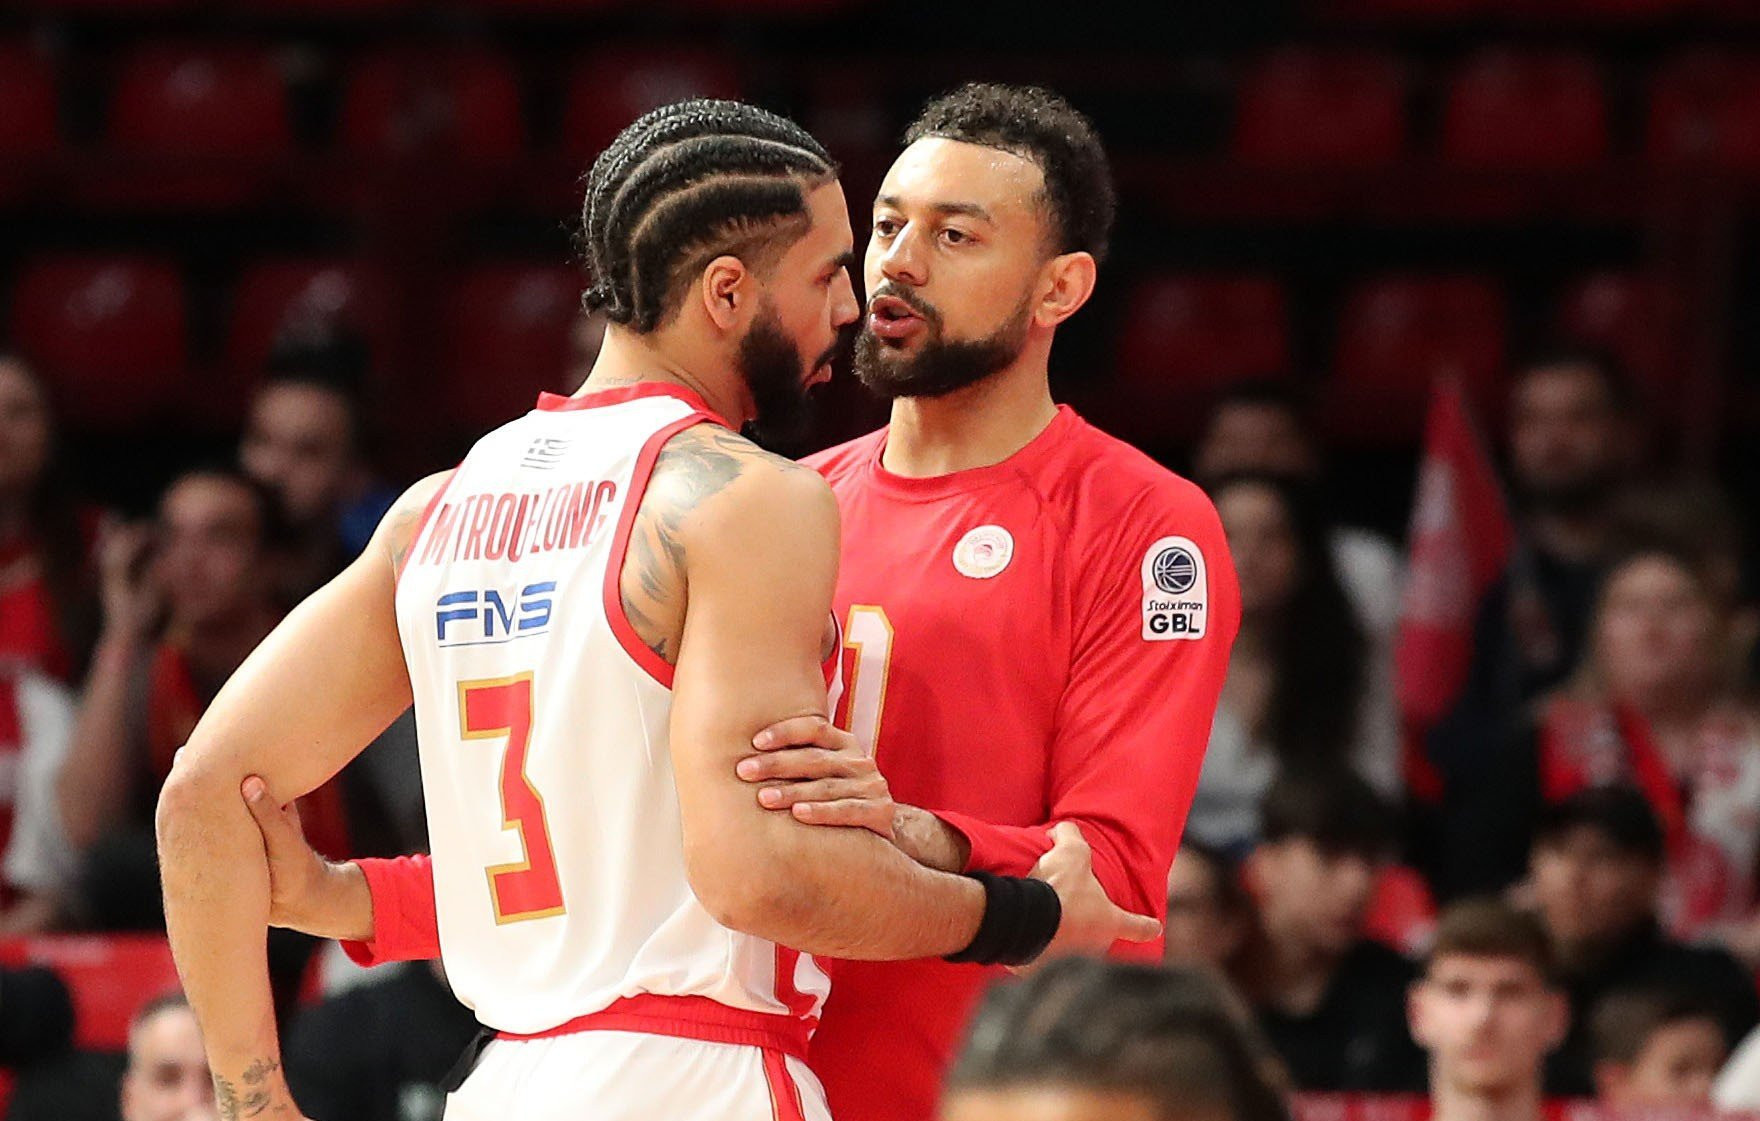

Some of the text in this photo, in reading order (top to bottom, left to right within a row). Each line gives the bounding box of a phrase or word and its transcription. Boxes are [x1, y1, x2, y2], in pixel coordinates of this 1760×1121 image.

[436, 580, 557, 641] FMS
[1146, 599, 1203, 612] Stoiximan
[1149, 613, 1200, 634] GBL
[456, 669, 567, 926] 3
